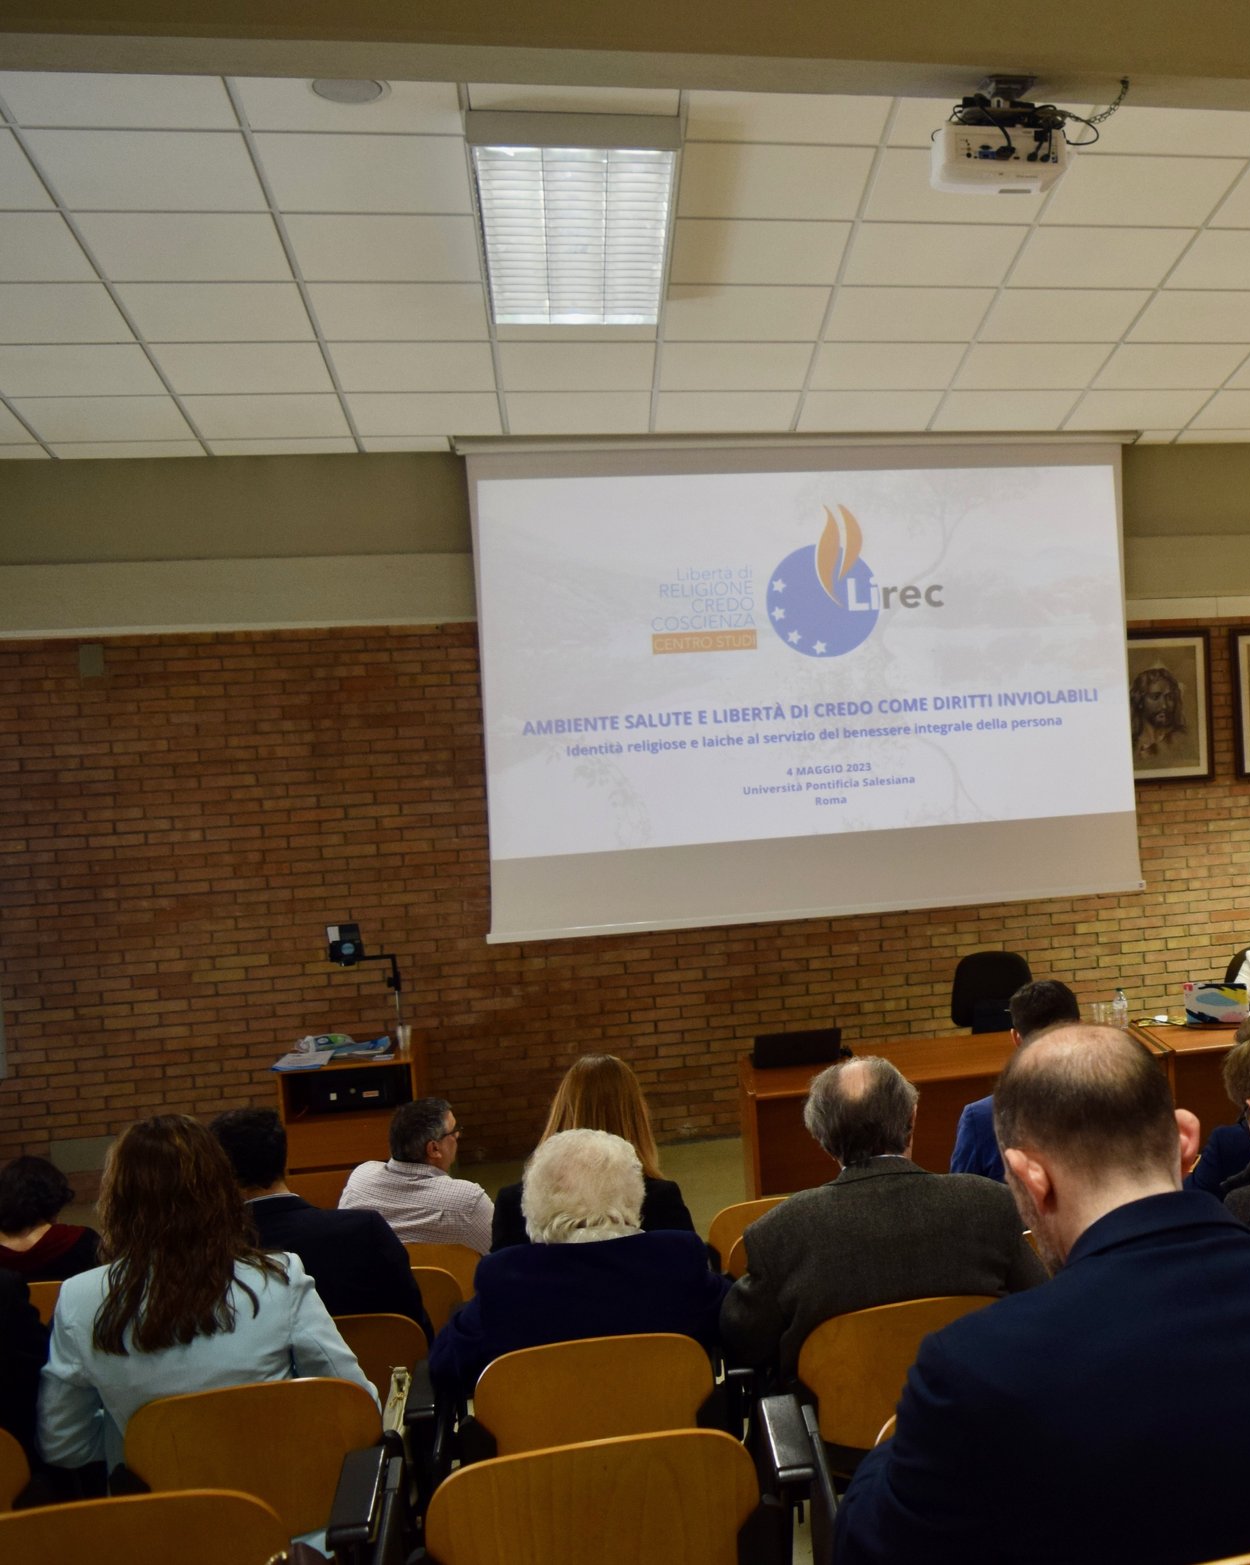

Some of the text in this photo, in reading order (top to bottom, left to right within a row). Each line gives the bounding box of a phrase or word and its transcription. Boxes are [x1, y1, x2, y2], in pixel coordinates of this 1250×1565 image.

[738, 564, 752, 579] di
[659, 581, 754, 599] RELIGIONE
[847, 575, 945, 611] Lirec
[691, 598, 755, 614] CREDO
[651, 614, 756, 632] COSCIENZA
[654, 633, 756, 651] CENTRO STUDI
[522, 688, 1098, 737] AMBIENTE SALUTE E LIBERTÀ DI CREDO COME DIRITTI INVIOLABILI
[566, 715, 1063, 757] Identità religiose e laiche al servizio del benessere integrale della persona
[786, 762, 872, 777] 4 MAGGIO 2023
[743, 775, 916, 795] Università Pontificia Salesiana
[815, 796, 848, 806] Roma
